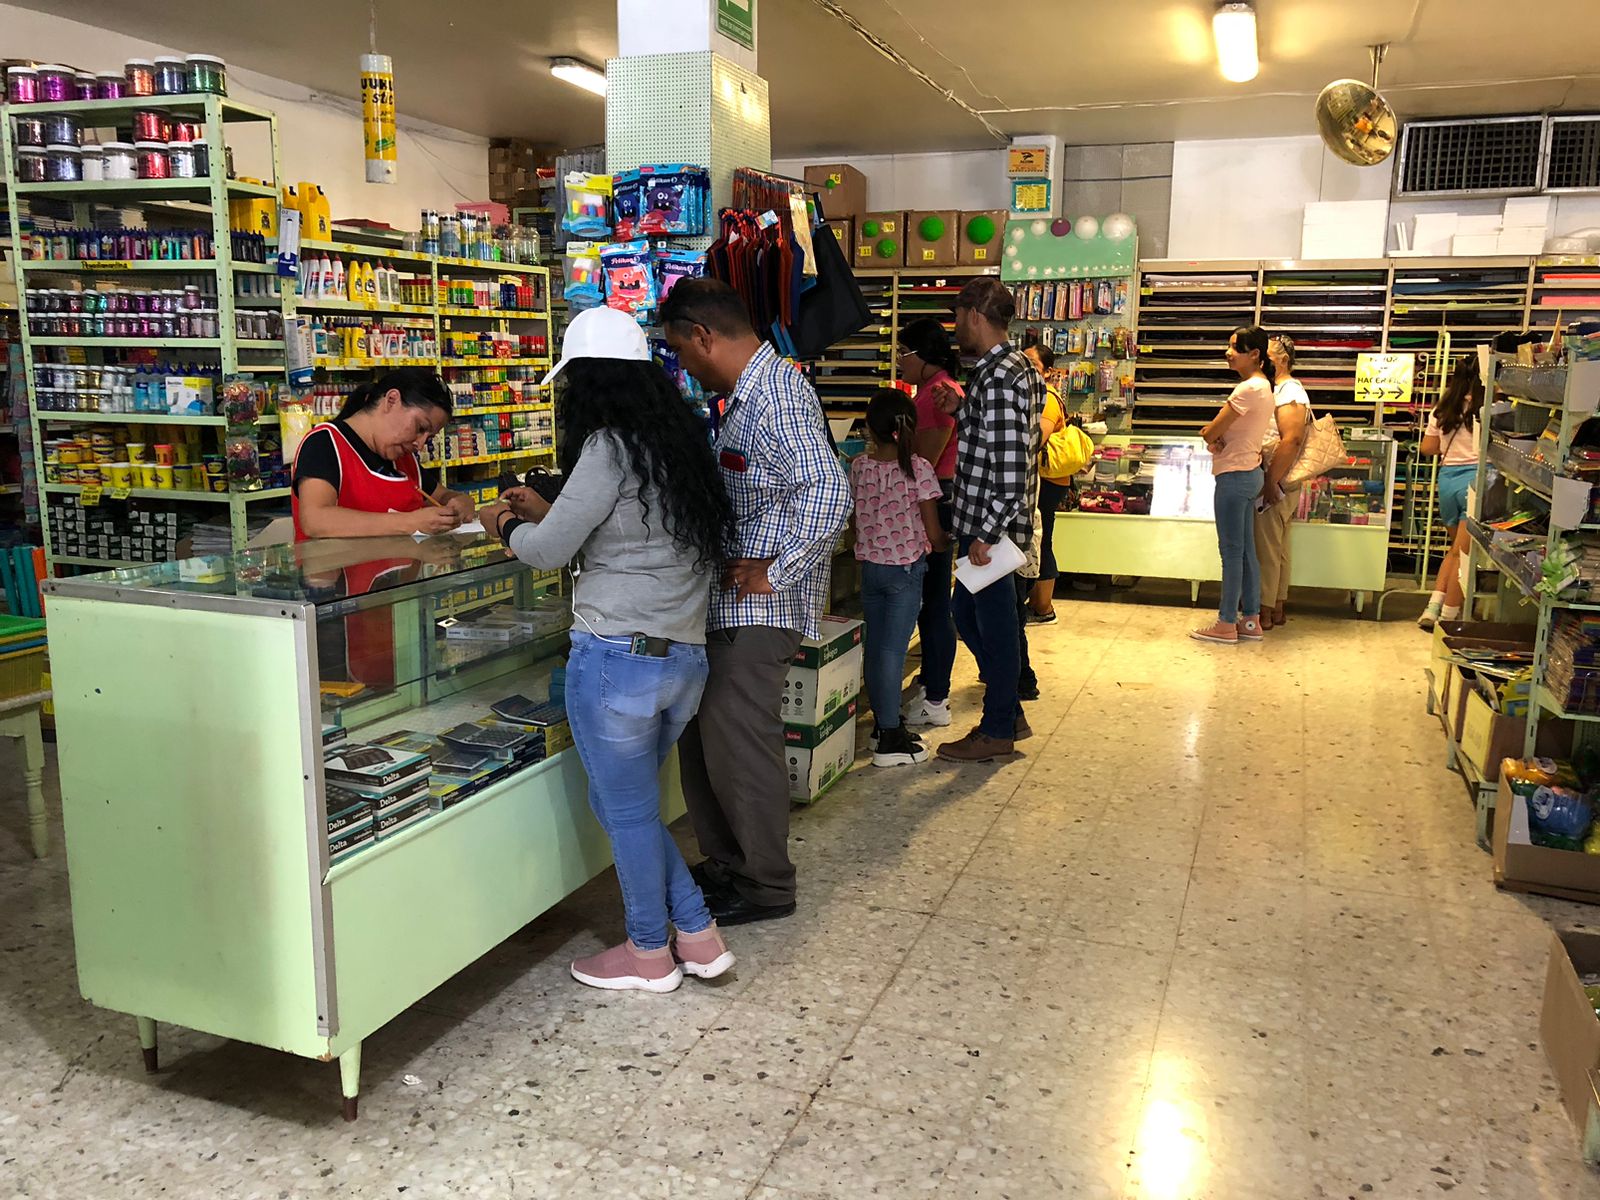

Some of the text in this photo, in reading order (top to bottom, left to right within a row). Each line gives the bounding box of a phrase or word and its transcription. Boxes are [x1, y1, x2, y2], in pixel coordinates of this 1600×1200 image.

[382, 772, 401, 785] Delta
[380, 795, 398, 808] Delta
[328, 819, 347, 831] Delta
[380, 816, 398, 829] Delta
[329, 840, 348, 853] Delta
